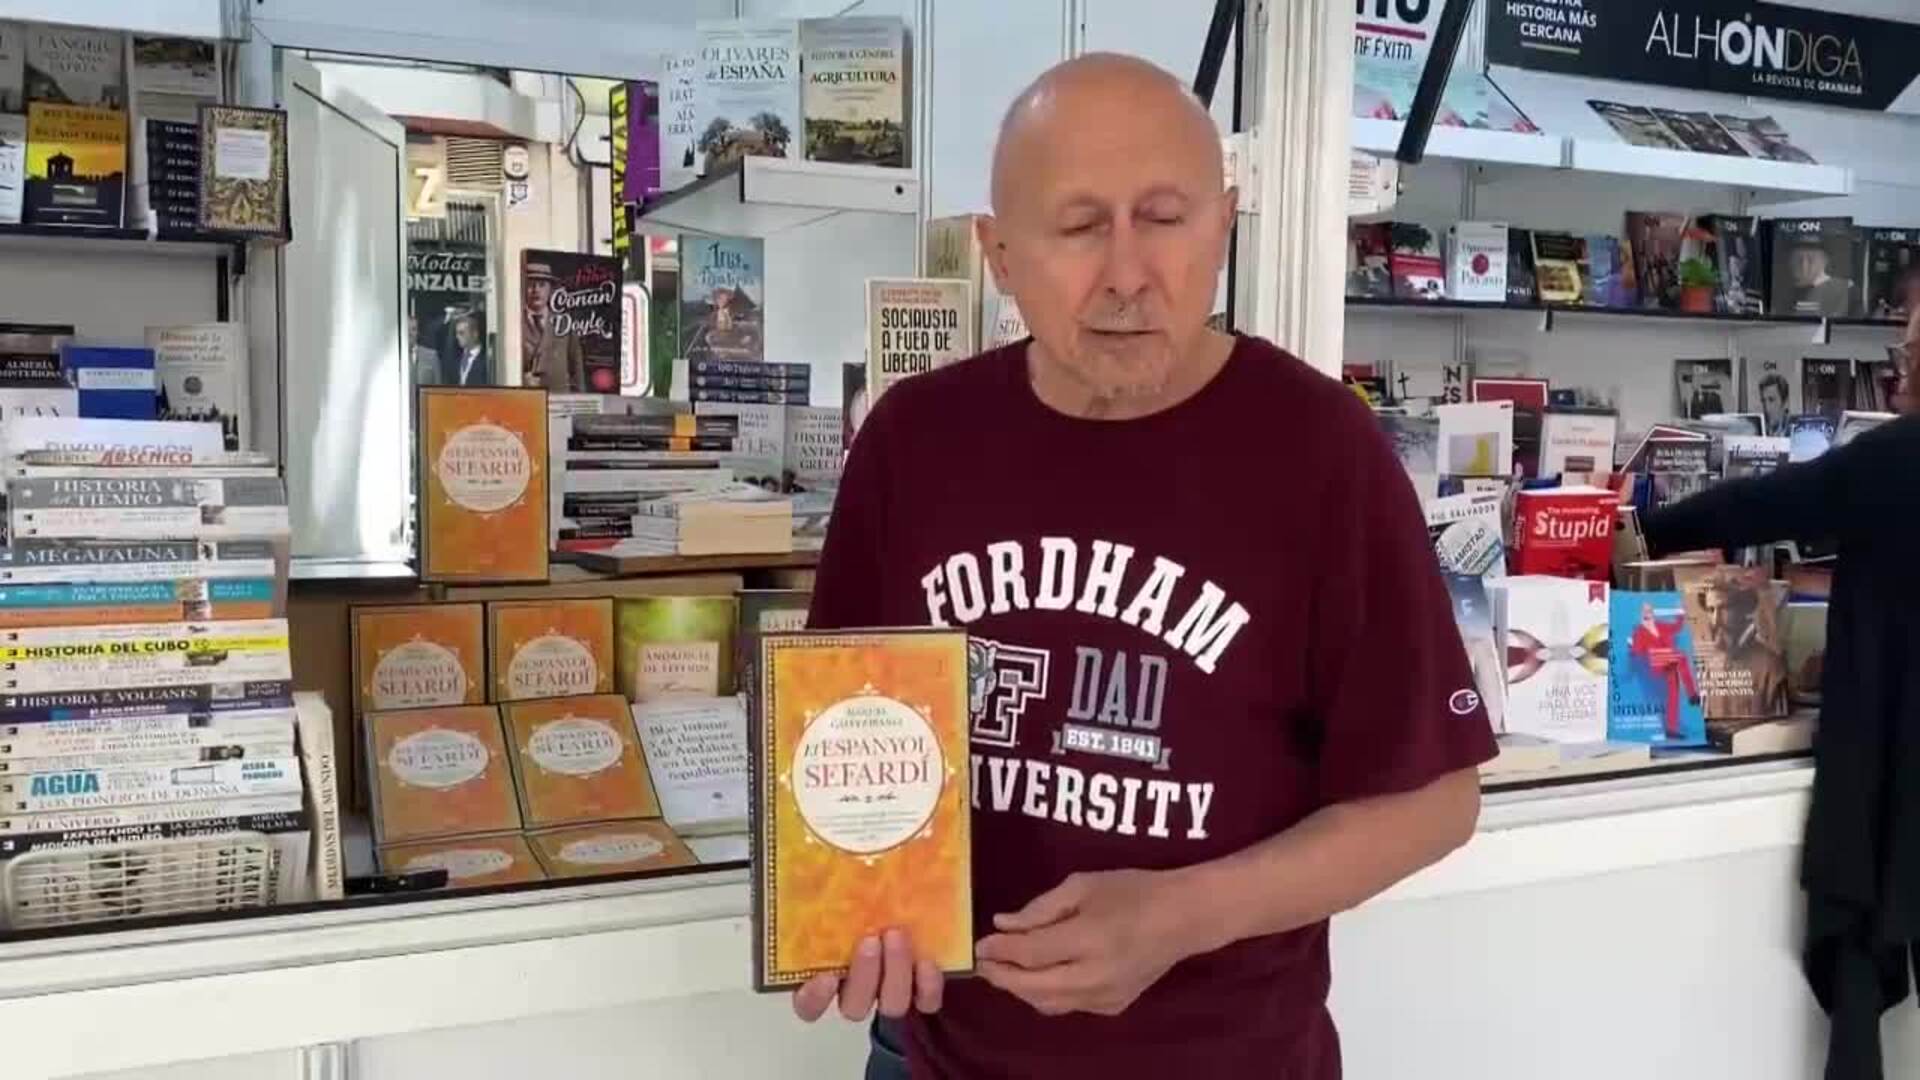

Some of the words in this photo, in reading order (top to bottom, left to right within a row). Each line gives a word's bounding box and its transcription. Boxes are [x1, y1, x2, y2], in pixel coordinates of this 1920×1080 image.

[1506, 4, 1565, 22] HISTORIA
[1567, 8, 1597, 27] MÁS
[1520, 22, 1582, 43] CERCANA
[701, 47, 791, 62] OLIVARES
[719, 60, 785, 80] ESPAÑA
[809, 71, 897, 84] AGRICULTURA
[1752, 73, 1764, 83] LA
[1766, 75, 1801, 88] REVISTA
[1804, 79, 1815, 90] DE
[1817, 80, 1862, 95] GRANADA
[408, 252, 472, 272] Modas
[549, 280, 616, 314] Conan
[552, 311, 613, 340] Doyle
[881, 308, 958, 330] SOCIALISTA
[881, 331, 891, 351] A
[898, 331, 932, 352] FUER
[934, 331, 953, 351] DE
[446, 461, 523, 476] SEFARDÍ
[53, 480, 162, 492] HISTORIA
[78, 493, 163, 506] TIEMPO
[1533, 509, 1610, 541] Stupid
[25, 548, 178, 563] MEGAFAUNA
[921, 536, 1251, 675] FORDHAM
[26, 645, 105, 658] HISTORIA
[110, 641, 139, 653] DEL
[144, 638, 190, 651] CUBO
[22, 695, 98, 708] HISTORIA
[117, 687, 198, 701] VOLCANES
[1067, 646, 1168, 729] DAD
[1067, 728, 1106, 750] EST.
[1112, 735, 1157, 758] 1841
[803, 755, 929, 788] SEFARDÍ
[31, 772, 99, 797] AGUA
[62, 827, 143, 840] EXPLORANDO
[146, 825, 162, 834] LA
